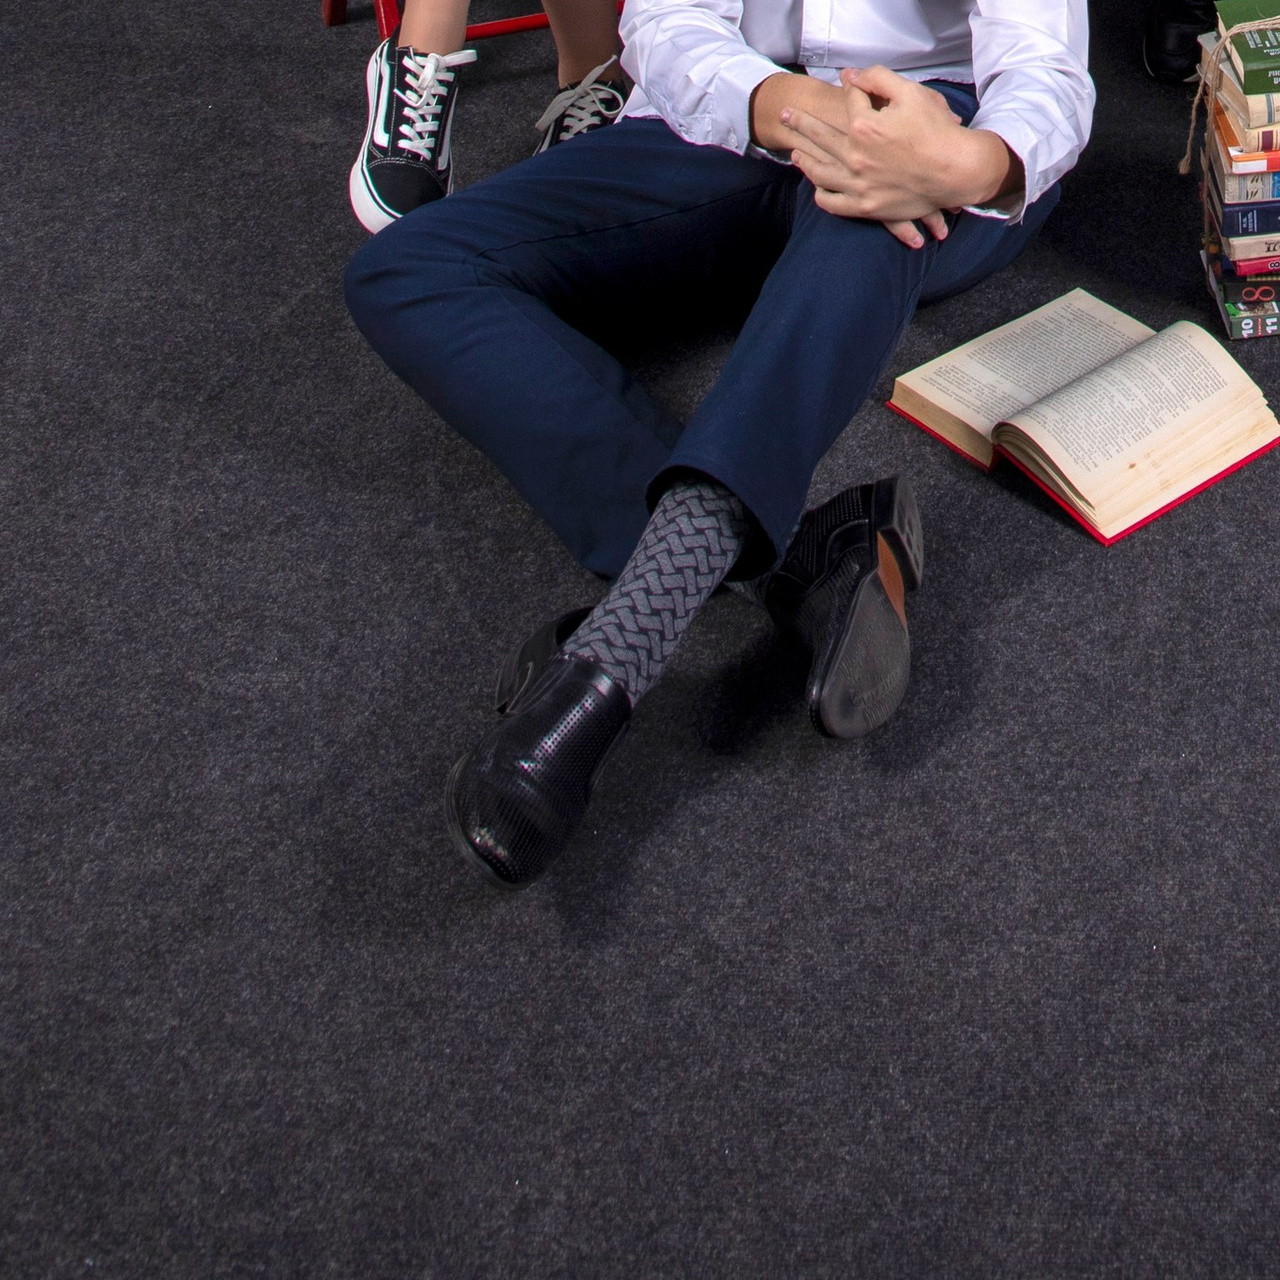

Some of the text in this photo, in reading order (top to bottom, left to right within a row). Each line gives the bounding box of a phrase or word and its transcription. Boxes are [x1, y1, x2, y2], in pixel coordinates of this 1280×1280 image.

[1268, 261, 1280, 269] 8
[1242, 286, 1275, 301] 8
[1241, 319, 1254, 338] 10
[1266, 317, 1278, 333] 11
